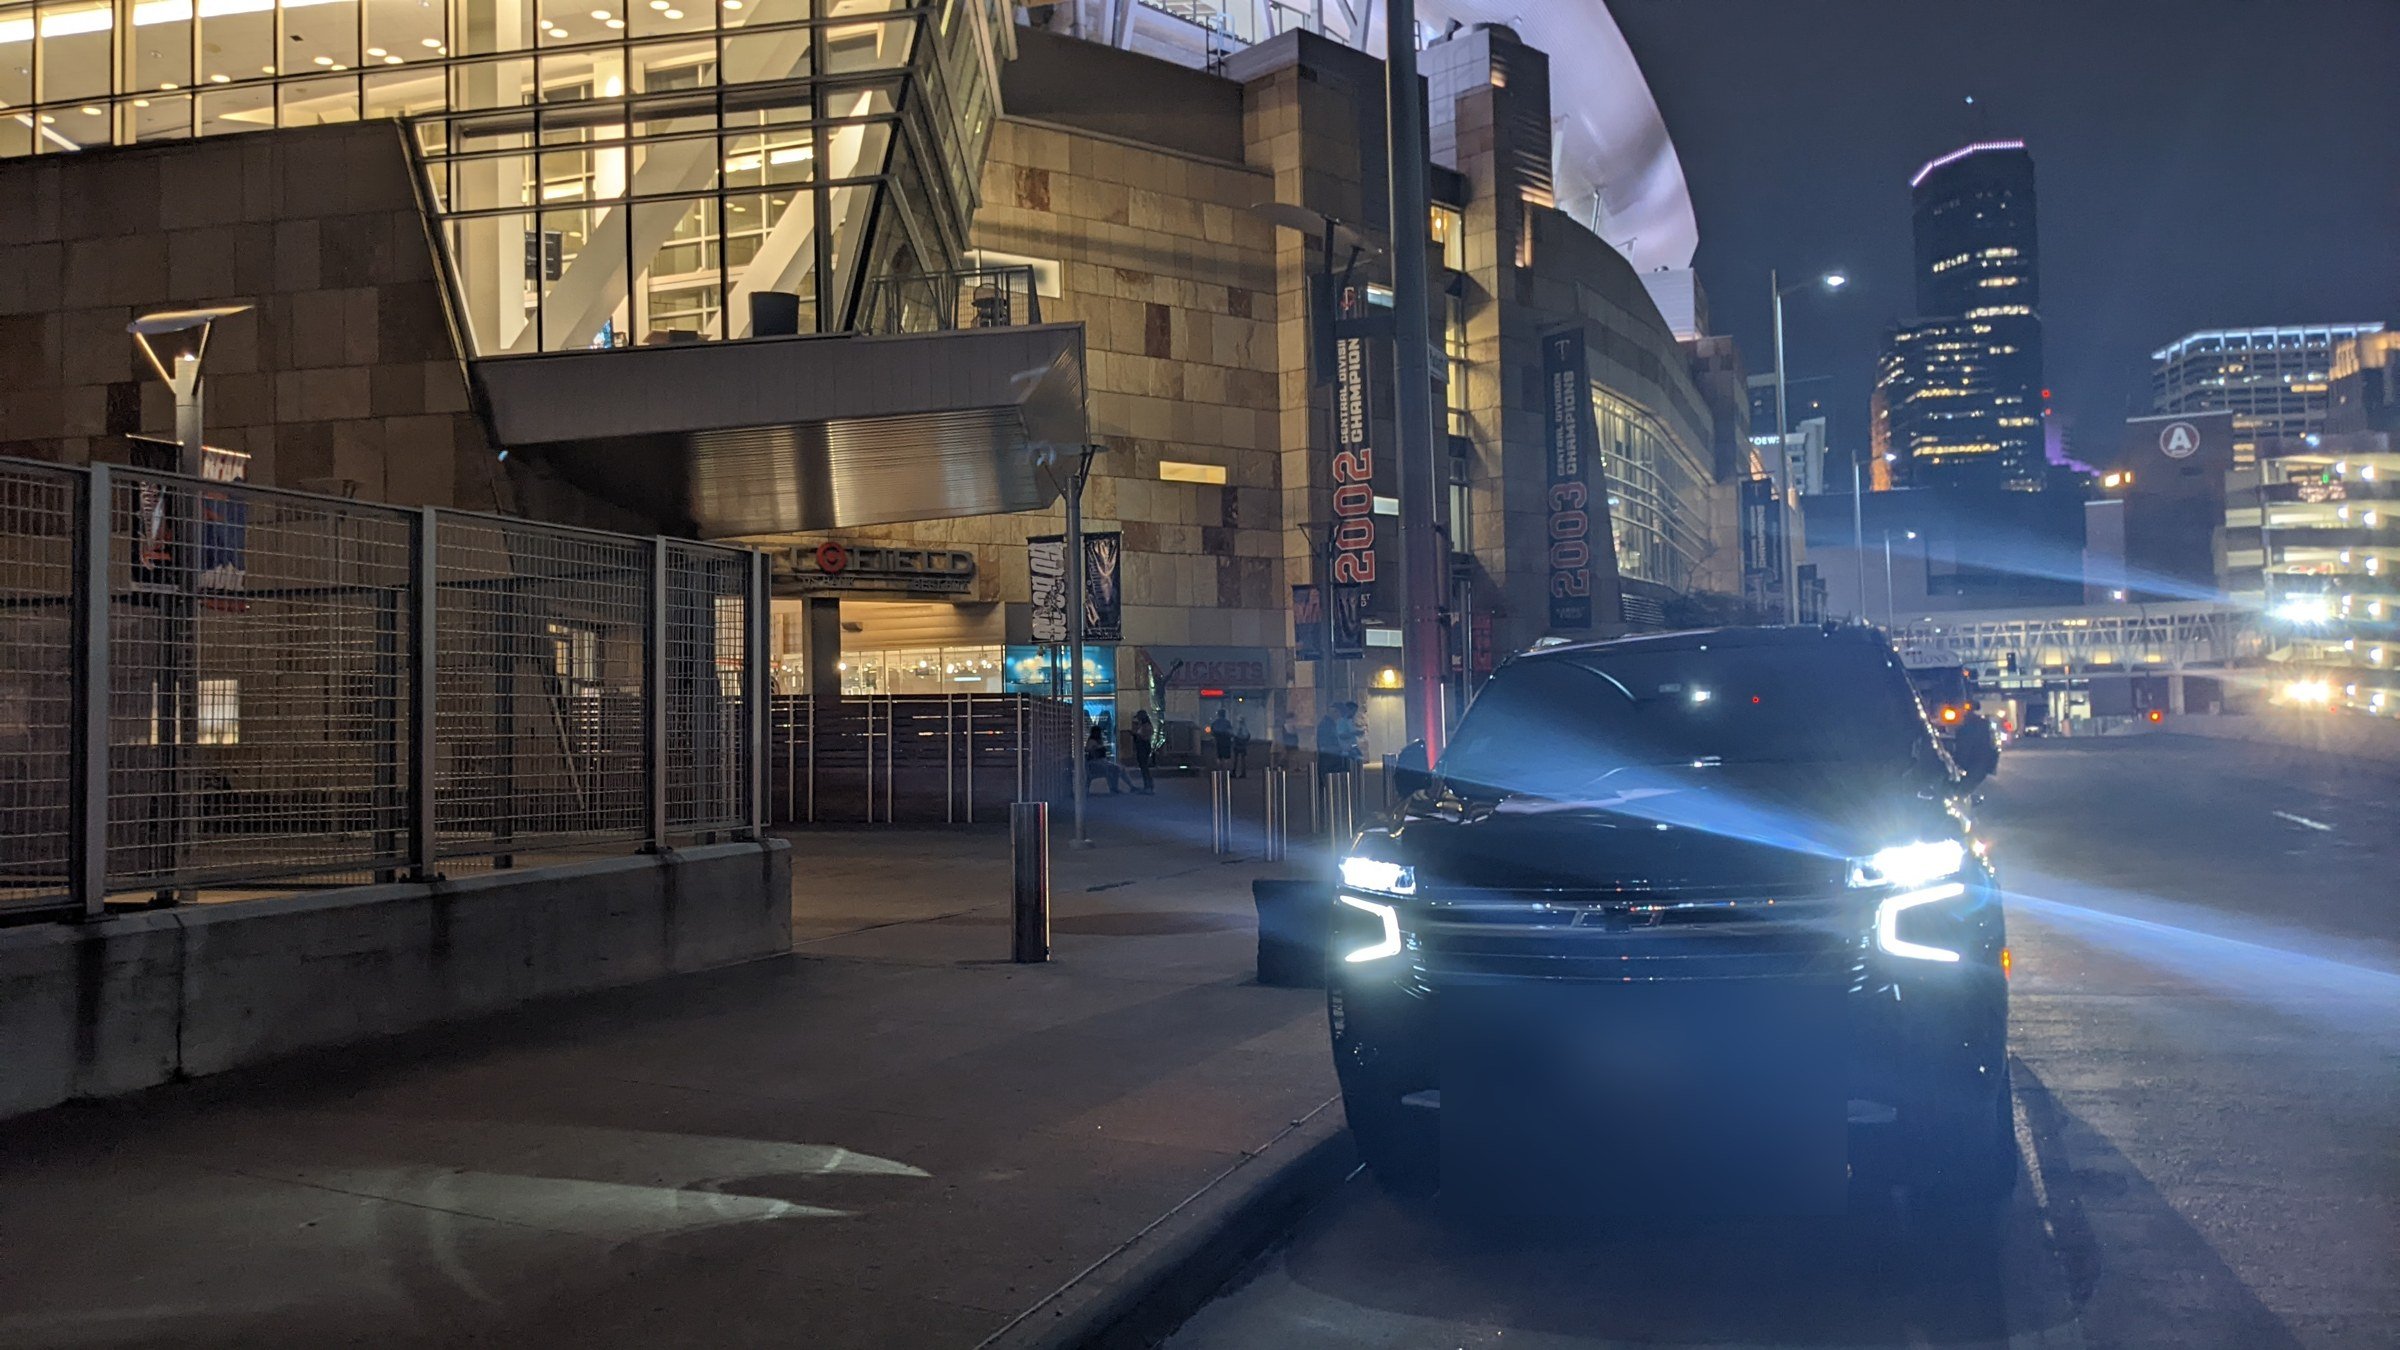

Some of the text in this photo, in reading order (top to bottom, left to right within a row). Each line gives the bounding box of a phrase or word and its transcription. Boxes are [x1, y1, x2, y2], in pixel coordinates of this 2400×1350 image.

[1339, 384, 1349, 444] CENTRAL
[1347, 337, 1363, 443] CHAMPION
[1562, 370, 1578, 475] CHAMPIONS
[2167, 427, 2192, 450] A
[1332, 448, 1376, 583] 2002
[1548, 481, 1590, 598] 2003
